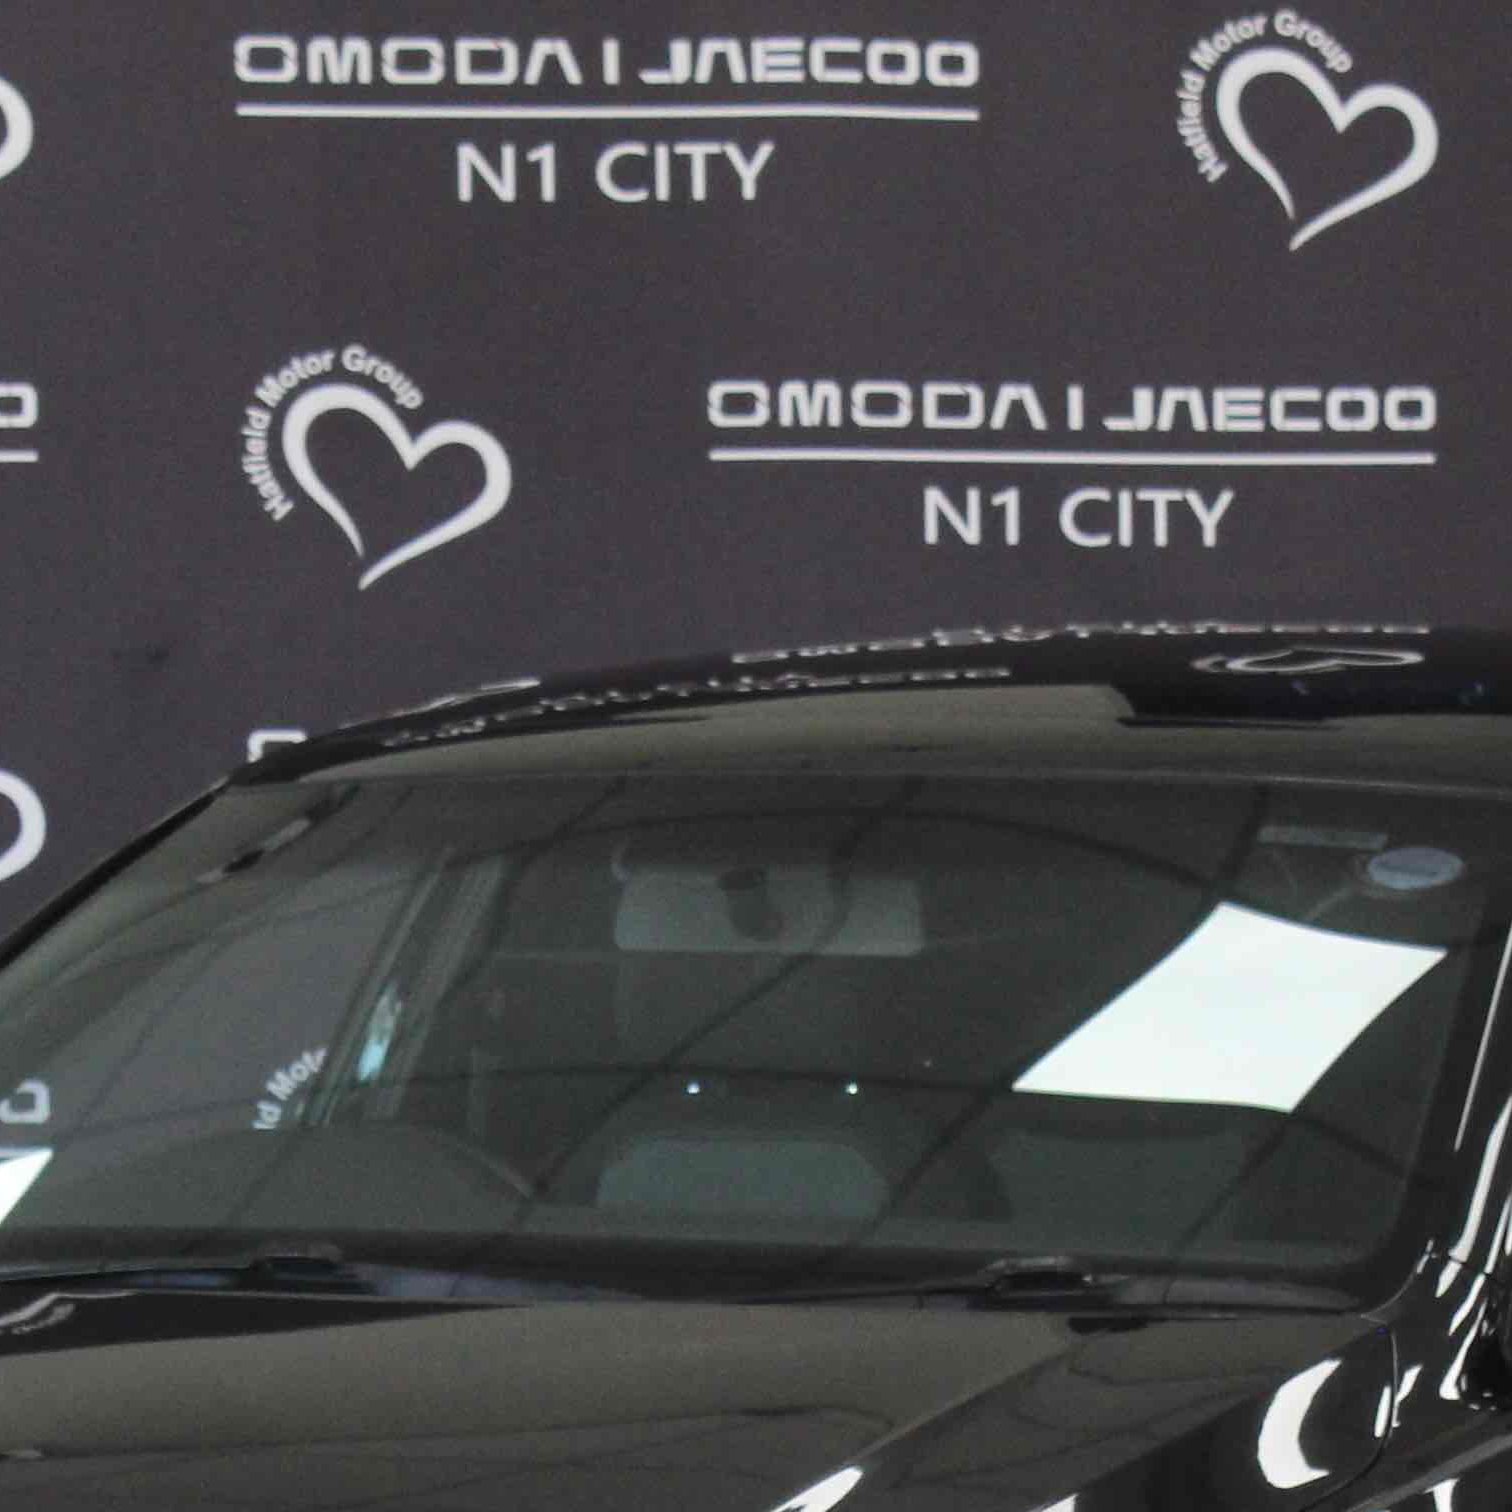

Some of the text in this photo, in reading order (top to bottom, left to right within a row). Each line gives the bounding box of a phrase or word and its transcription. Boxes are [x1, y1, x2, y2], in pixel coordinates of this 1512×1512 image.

[234, 35, 582, 85] OMODA
[639, 37, 980, 87] JAECOO
[1176, 9, 1353, 182] Hatfield Motor Group
[457, 141, 775, 203] N1 CITY
[241, 343, 424, 521] Hatfield Motor Group
[707, 380, 1047, 431] OMODA
[1103, 387, 1436, 432] JAECOO
[924, 486, 1234, 548] N1 CITY
